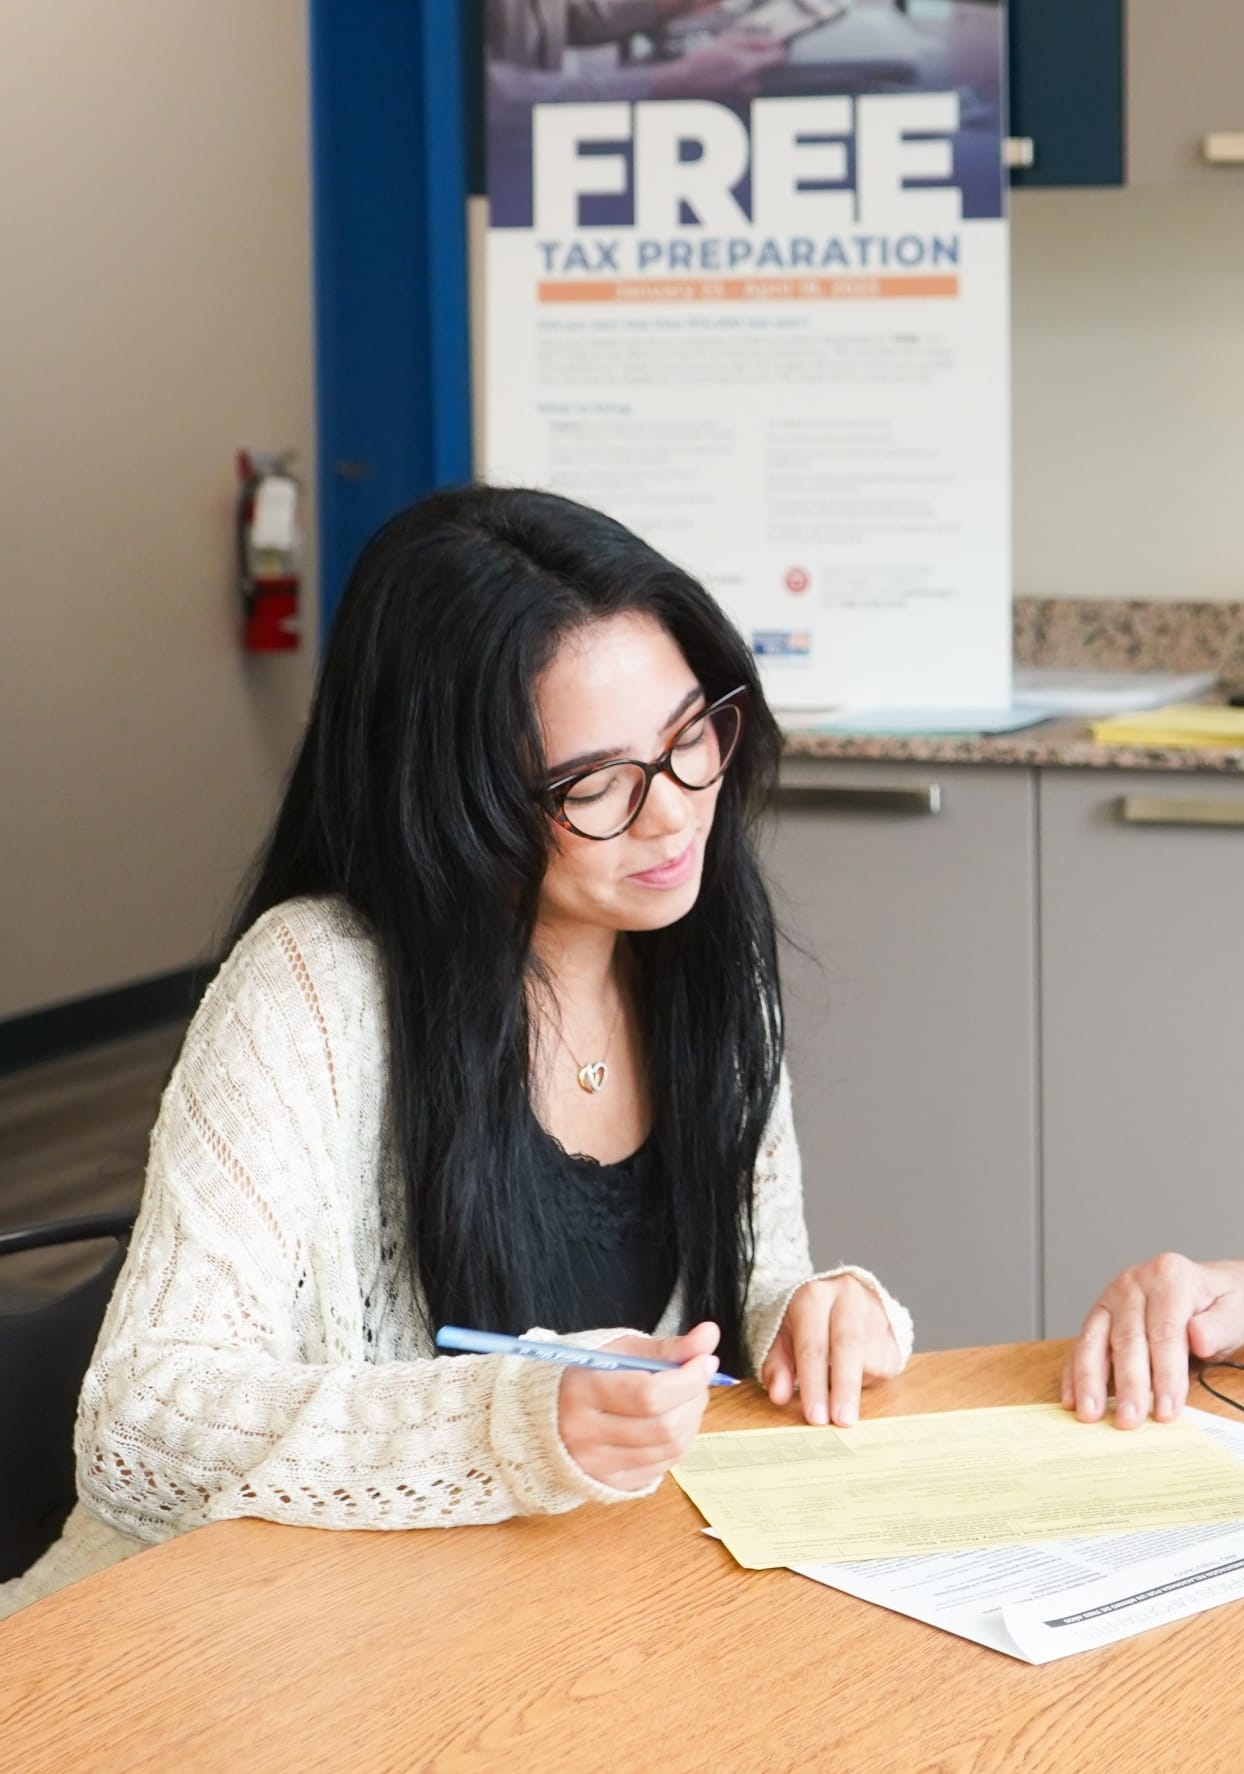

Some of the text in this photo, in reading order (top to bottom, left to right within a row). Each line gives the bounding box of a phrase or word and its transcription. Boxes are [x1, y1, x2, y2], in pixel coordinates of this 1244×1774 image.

[533, 91, 962, 230] FREE
[537, 234, 961, 272] TAX PREPARATION
